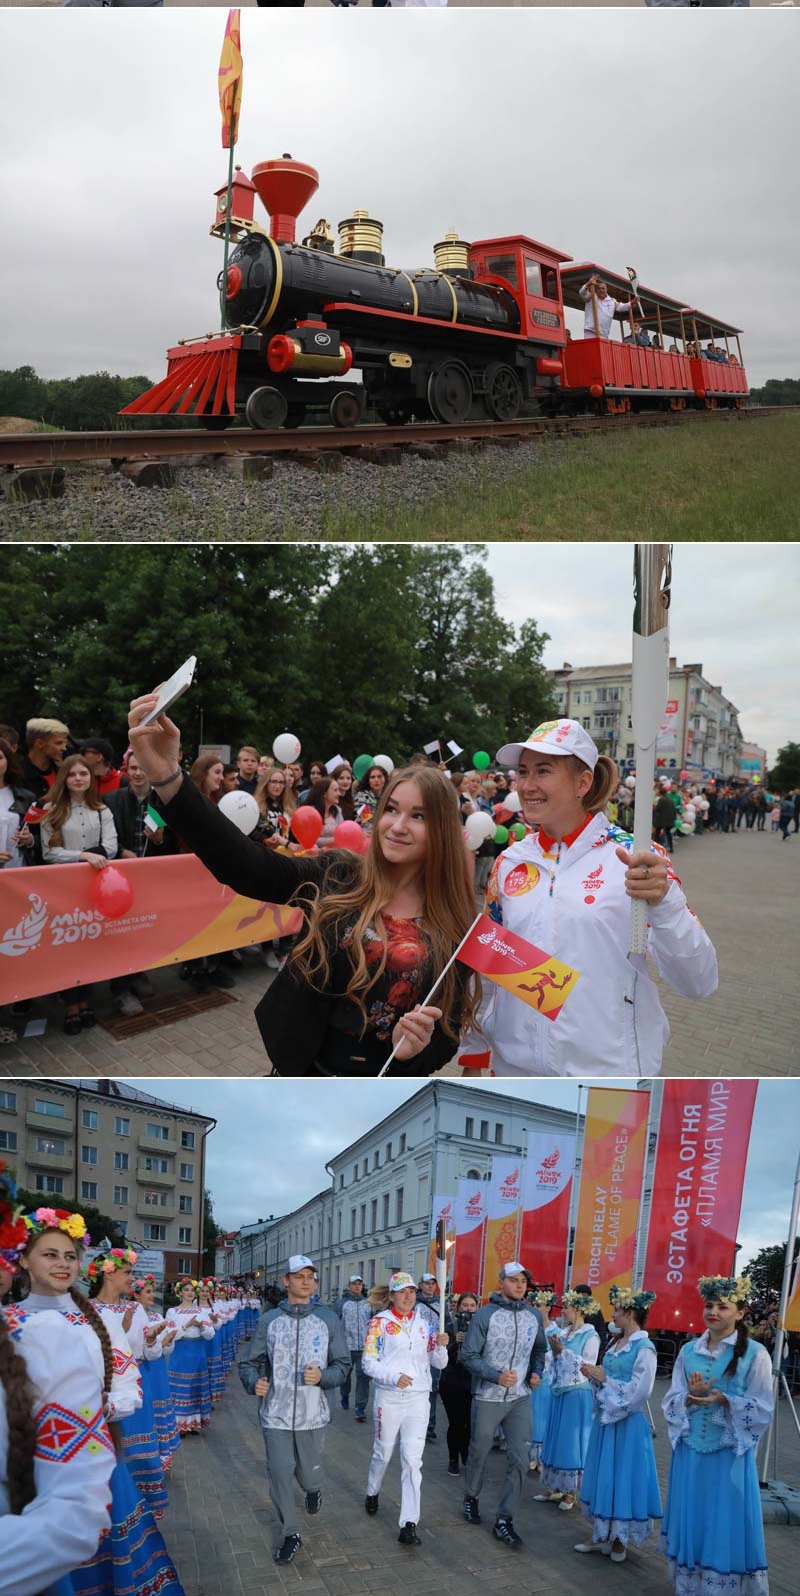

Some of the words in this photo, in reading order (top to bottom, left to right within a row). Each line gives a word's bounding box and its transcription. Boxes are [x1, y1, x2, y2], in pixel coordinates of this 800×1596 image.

[50, 907, 105, 929] MINS
[51, 922, 102, 946] 2019
[707, 1079, 732, 1133] МИР
[612, 1128, 630, 1183] PEACE»
[679, 1104, 703, 1161] ОГНЯ
[501, 1190, 518, 1198] 2019
[538, 1176, 558, 1185] 2019
[611, 1185, 623, 1205] OF
[695, 1137, 724, 1227] «ПЛАМЯ
[592, 1186, 608, 1233] RELAY
[666, 1166, 695, 1284] ЭСТАФЕТА
[604, 1207, 621, 1263] «FLAME
[587, 1236, 603, 1286] TORCH
